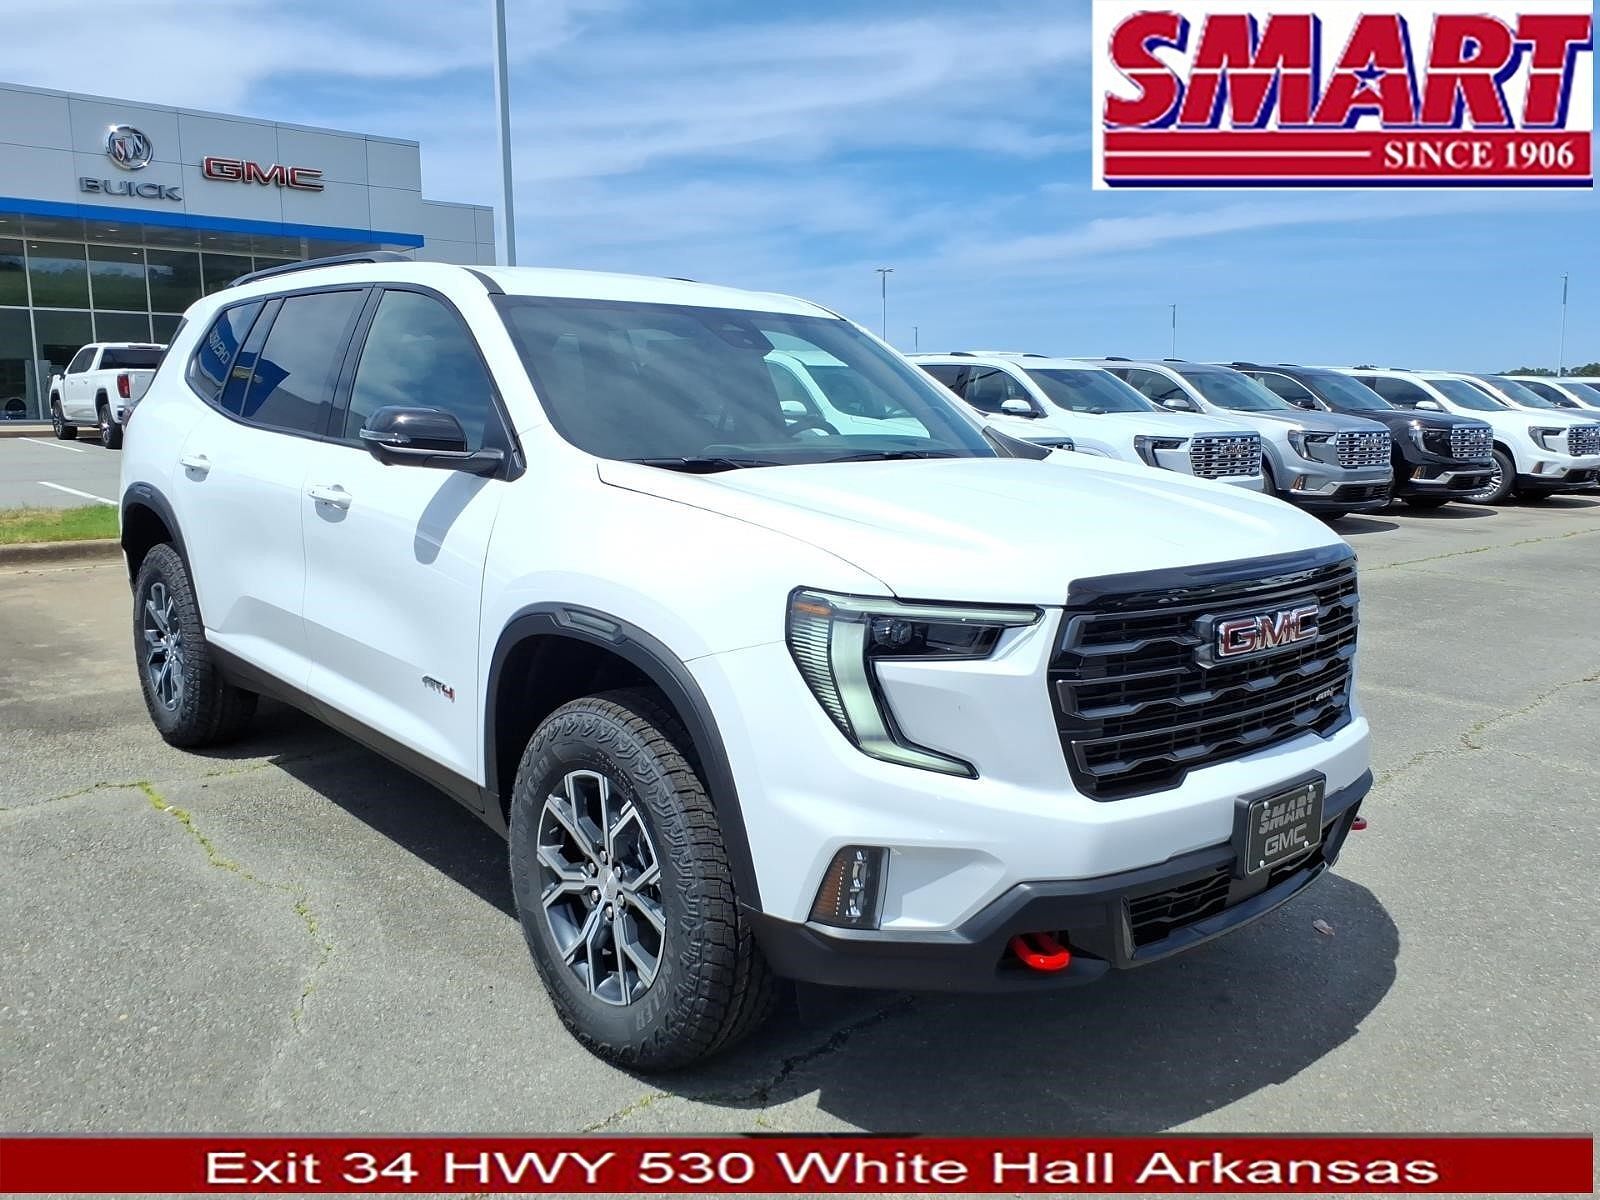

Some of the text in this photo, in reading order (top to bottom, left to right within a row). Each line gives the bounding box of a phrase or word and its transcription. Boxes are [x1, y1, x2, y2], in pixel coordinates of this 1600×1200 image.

[79, 176, 183, 202] BUICK
[202, 155, 325, 192] GMC
[1218, 604, 1319, 657] GMC
[1258, 791, 1317, 834] SMART
[1264, 823, 1307, 856] GMC
